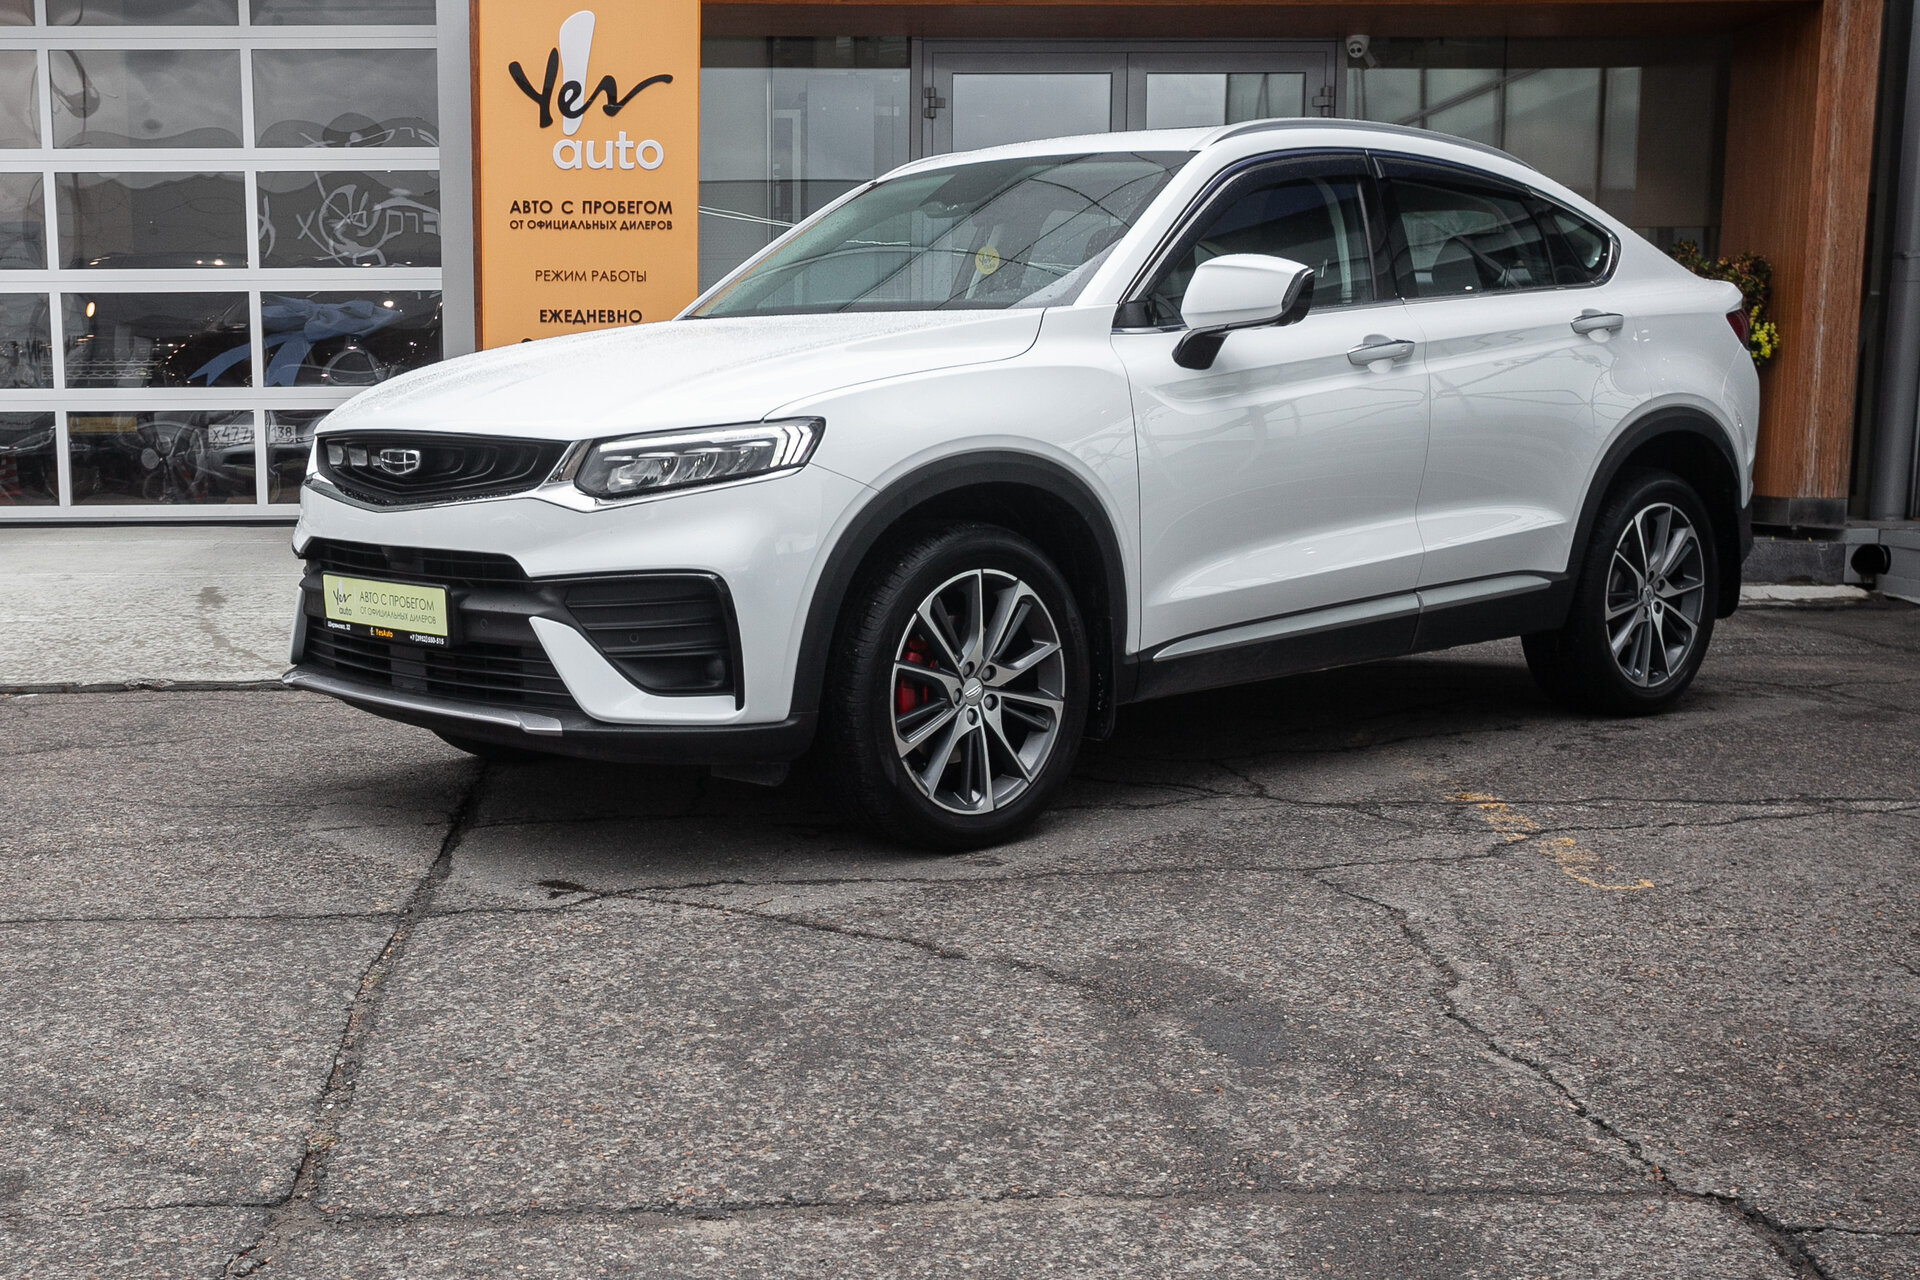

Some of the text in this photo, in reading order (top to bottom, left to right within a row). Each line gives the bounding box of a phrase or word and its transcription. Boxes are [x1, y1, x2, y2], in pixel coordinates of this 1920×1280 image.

[508, 47, 673, 128] Yes
[552, 131, 664, 170] auto
[509, 200, 673, 215] АВТО С ПРОБЕГОМ
[509, 219, 673, 231] ОТ ОФИЦИАЛЬНЫХ ДИЛЕРОВ
[535, 270, 647, 282] РЕЖИМ РАБОТЫ
[539, 309, 643, 324] ЕЖЕДНЕВНО
[271, 426, 293, 438] 138
[359, 591, 435, 612] АВТО С ПРОБЕГОМ
[360, 606, 368, 615] ОТ
[409, 613, 437, 625] ДИЛЕРОВ
